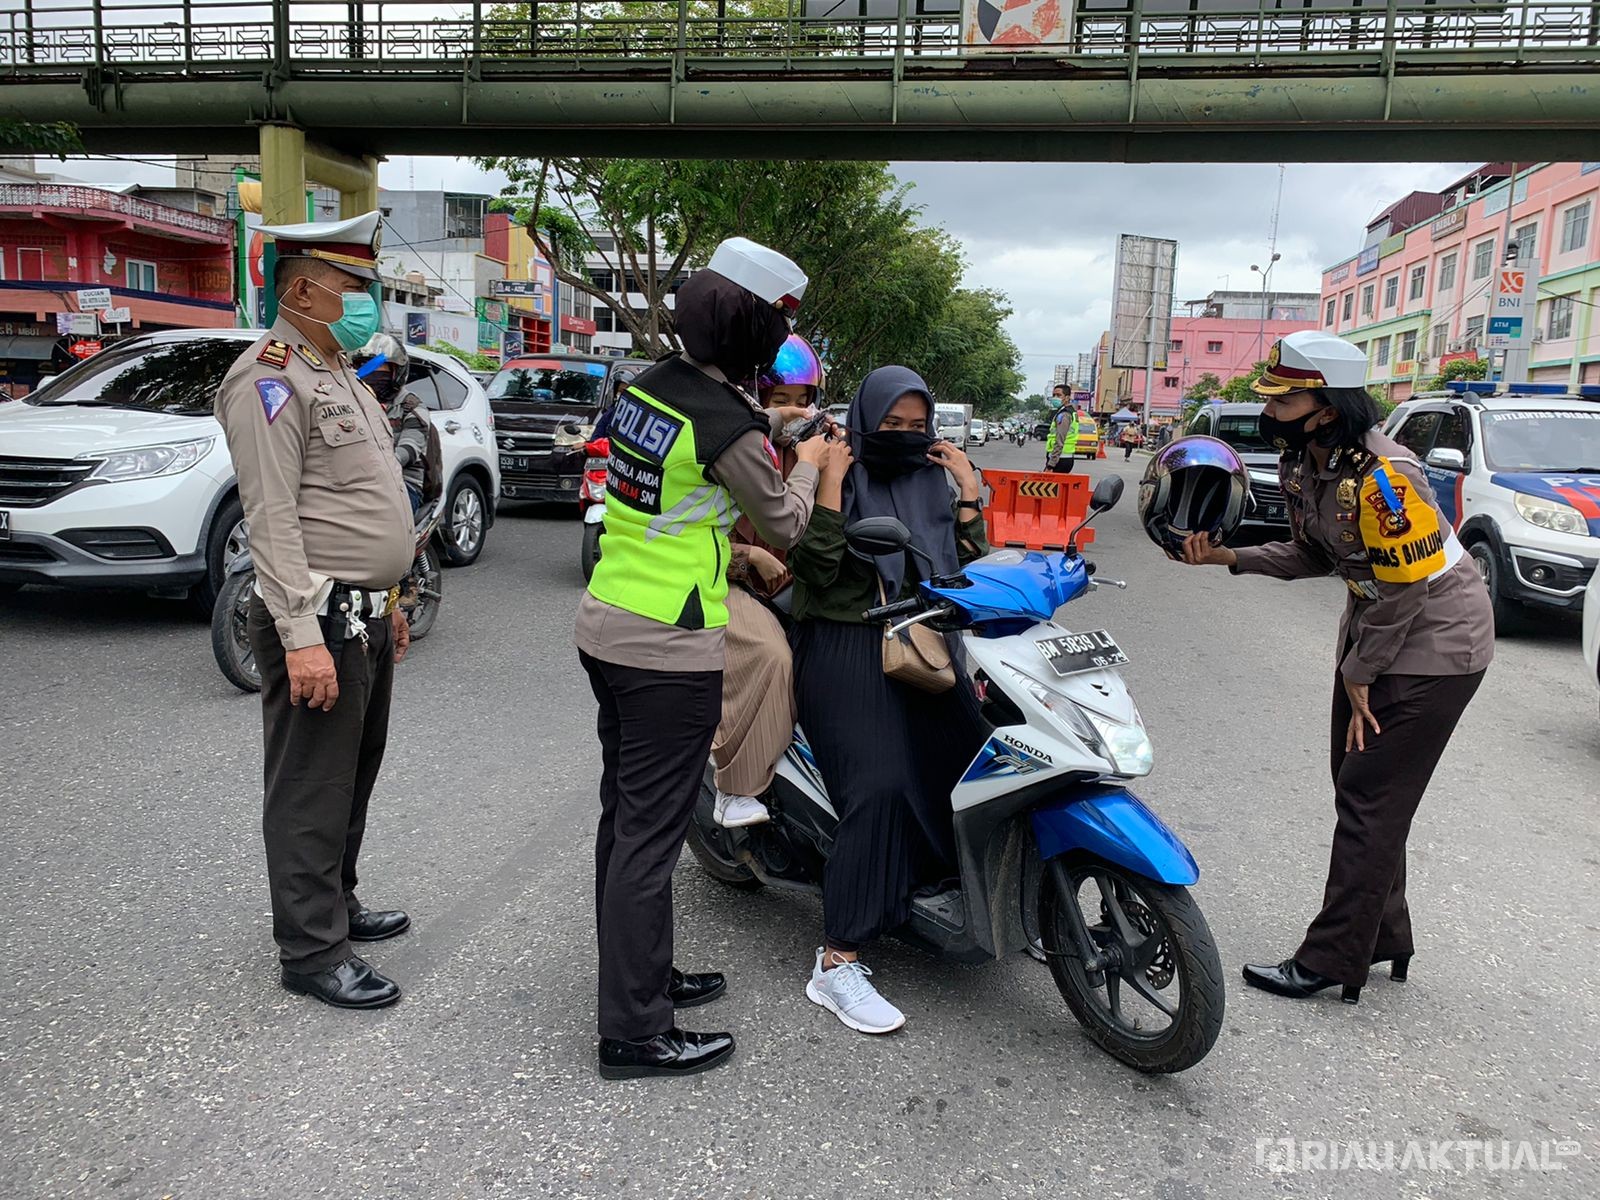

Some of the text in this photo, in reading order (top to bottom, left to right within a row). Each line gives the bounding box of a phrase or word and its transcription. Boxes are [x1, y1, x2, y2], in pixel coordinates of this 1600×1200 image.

[111, 194, 218, 235] Paling Indonesia
[1498, 297, 1520, 308] BNI
[611, 395, 678, 458] POLISI
[1493, 411, 1555, 421] DITLANTAS
[1556, 411, 1591, 420] POLDA
[635, 469, 659, 488] ANDA
[640, 489, 656, 506] SNI
[1037, 640, 1062, 659] BM
[1058, 634, 1096, 654] 5839
[1004, 734, 1054, 764] HONDA
